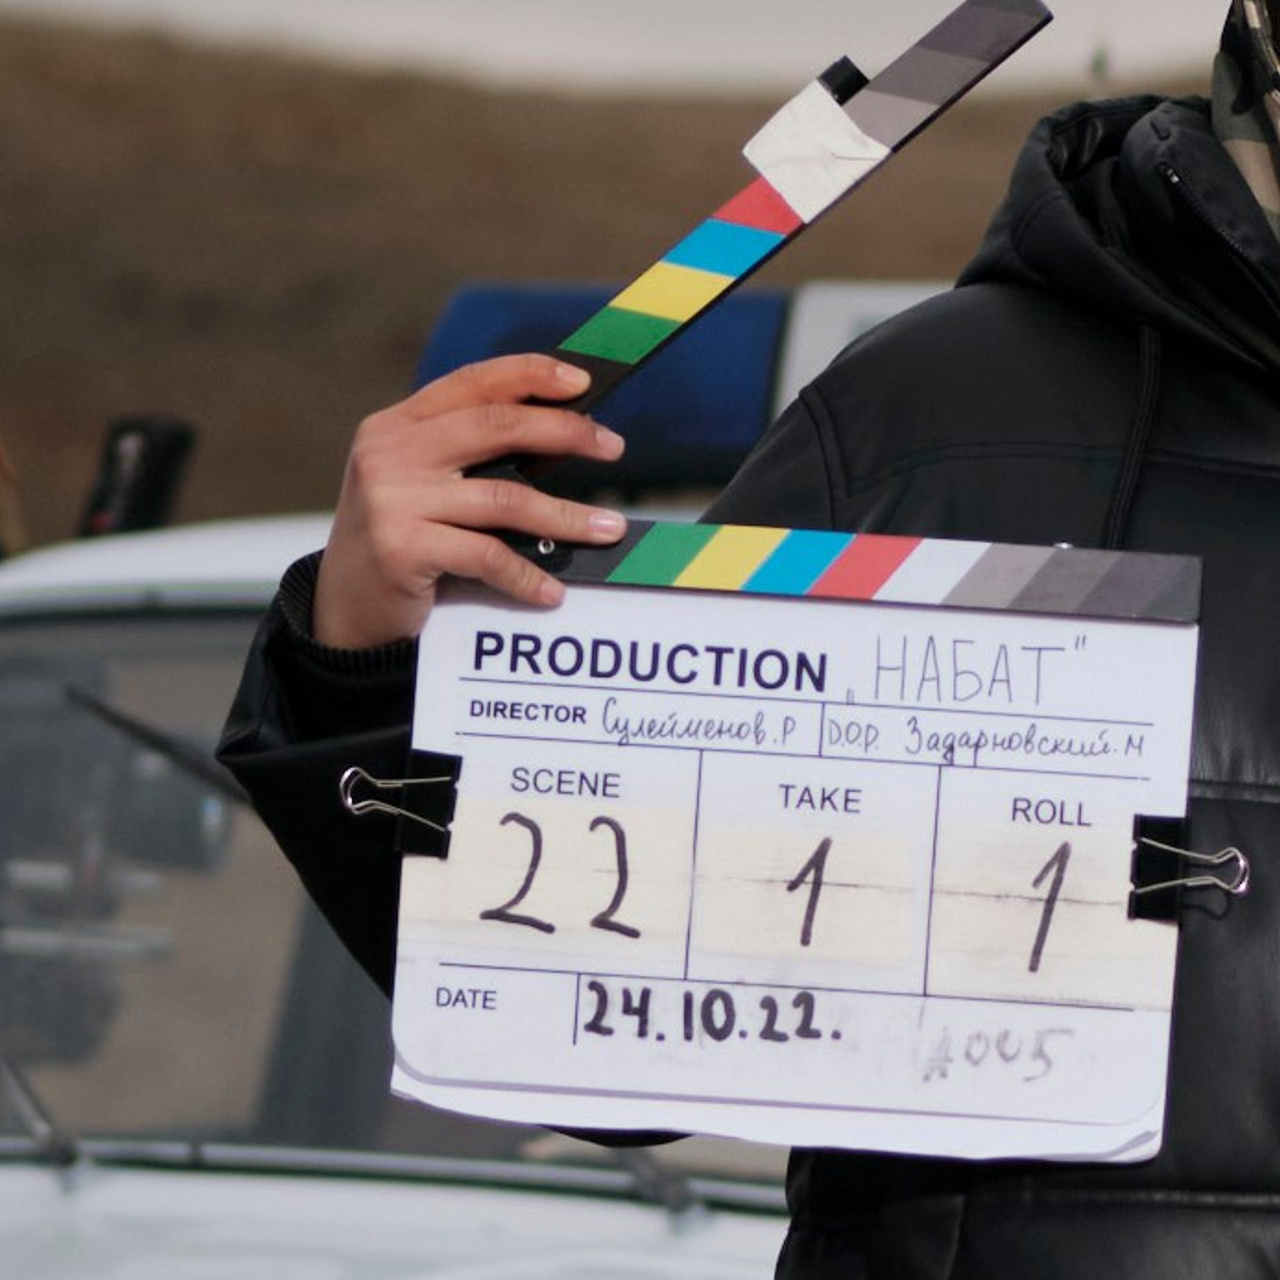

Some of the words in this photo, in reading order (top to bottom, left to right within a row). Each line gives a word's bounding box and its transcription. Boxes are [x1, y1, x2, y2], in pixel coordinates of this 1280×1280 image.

[473, 630, 828, 693] PRODUCTION
[469, 699, 587, 725] DIRECTOR
[510, 766, 622, 799] SCENE
[778, 783, 863, 814] TAKE
[1011, 797, 1093, 827] ROLL
[479, 811, 641, 939] 22
[786, 836, 833, 947] 1
[1028, 841, 1072, 973] 1
[435, 987, 498, 1011] DATE
